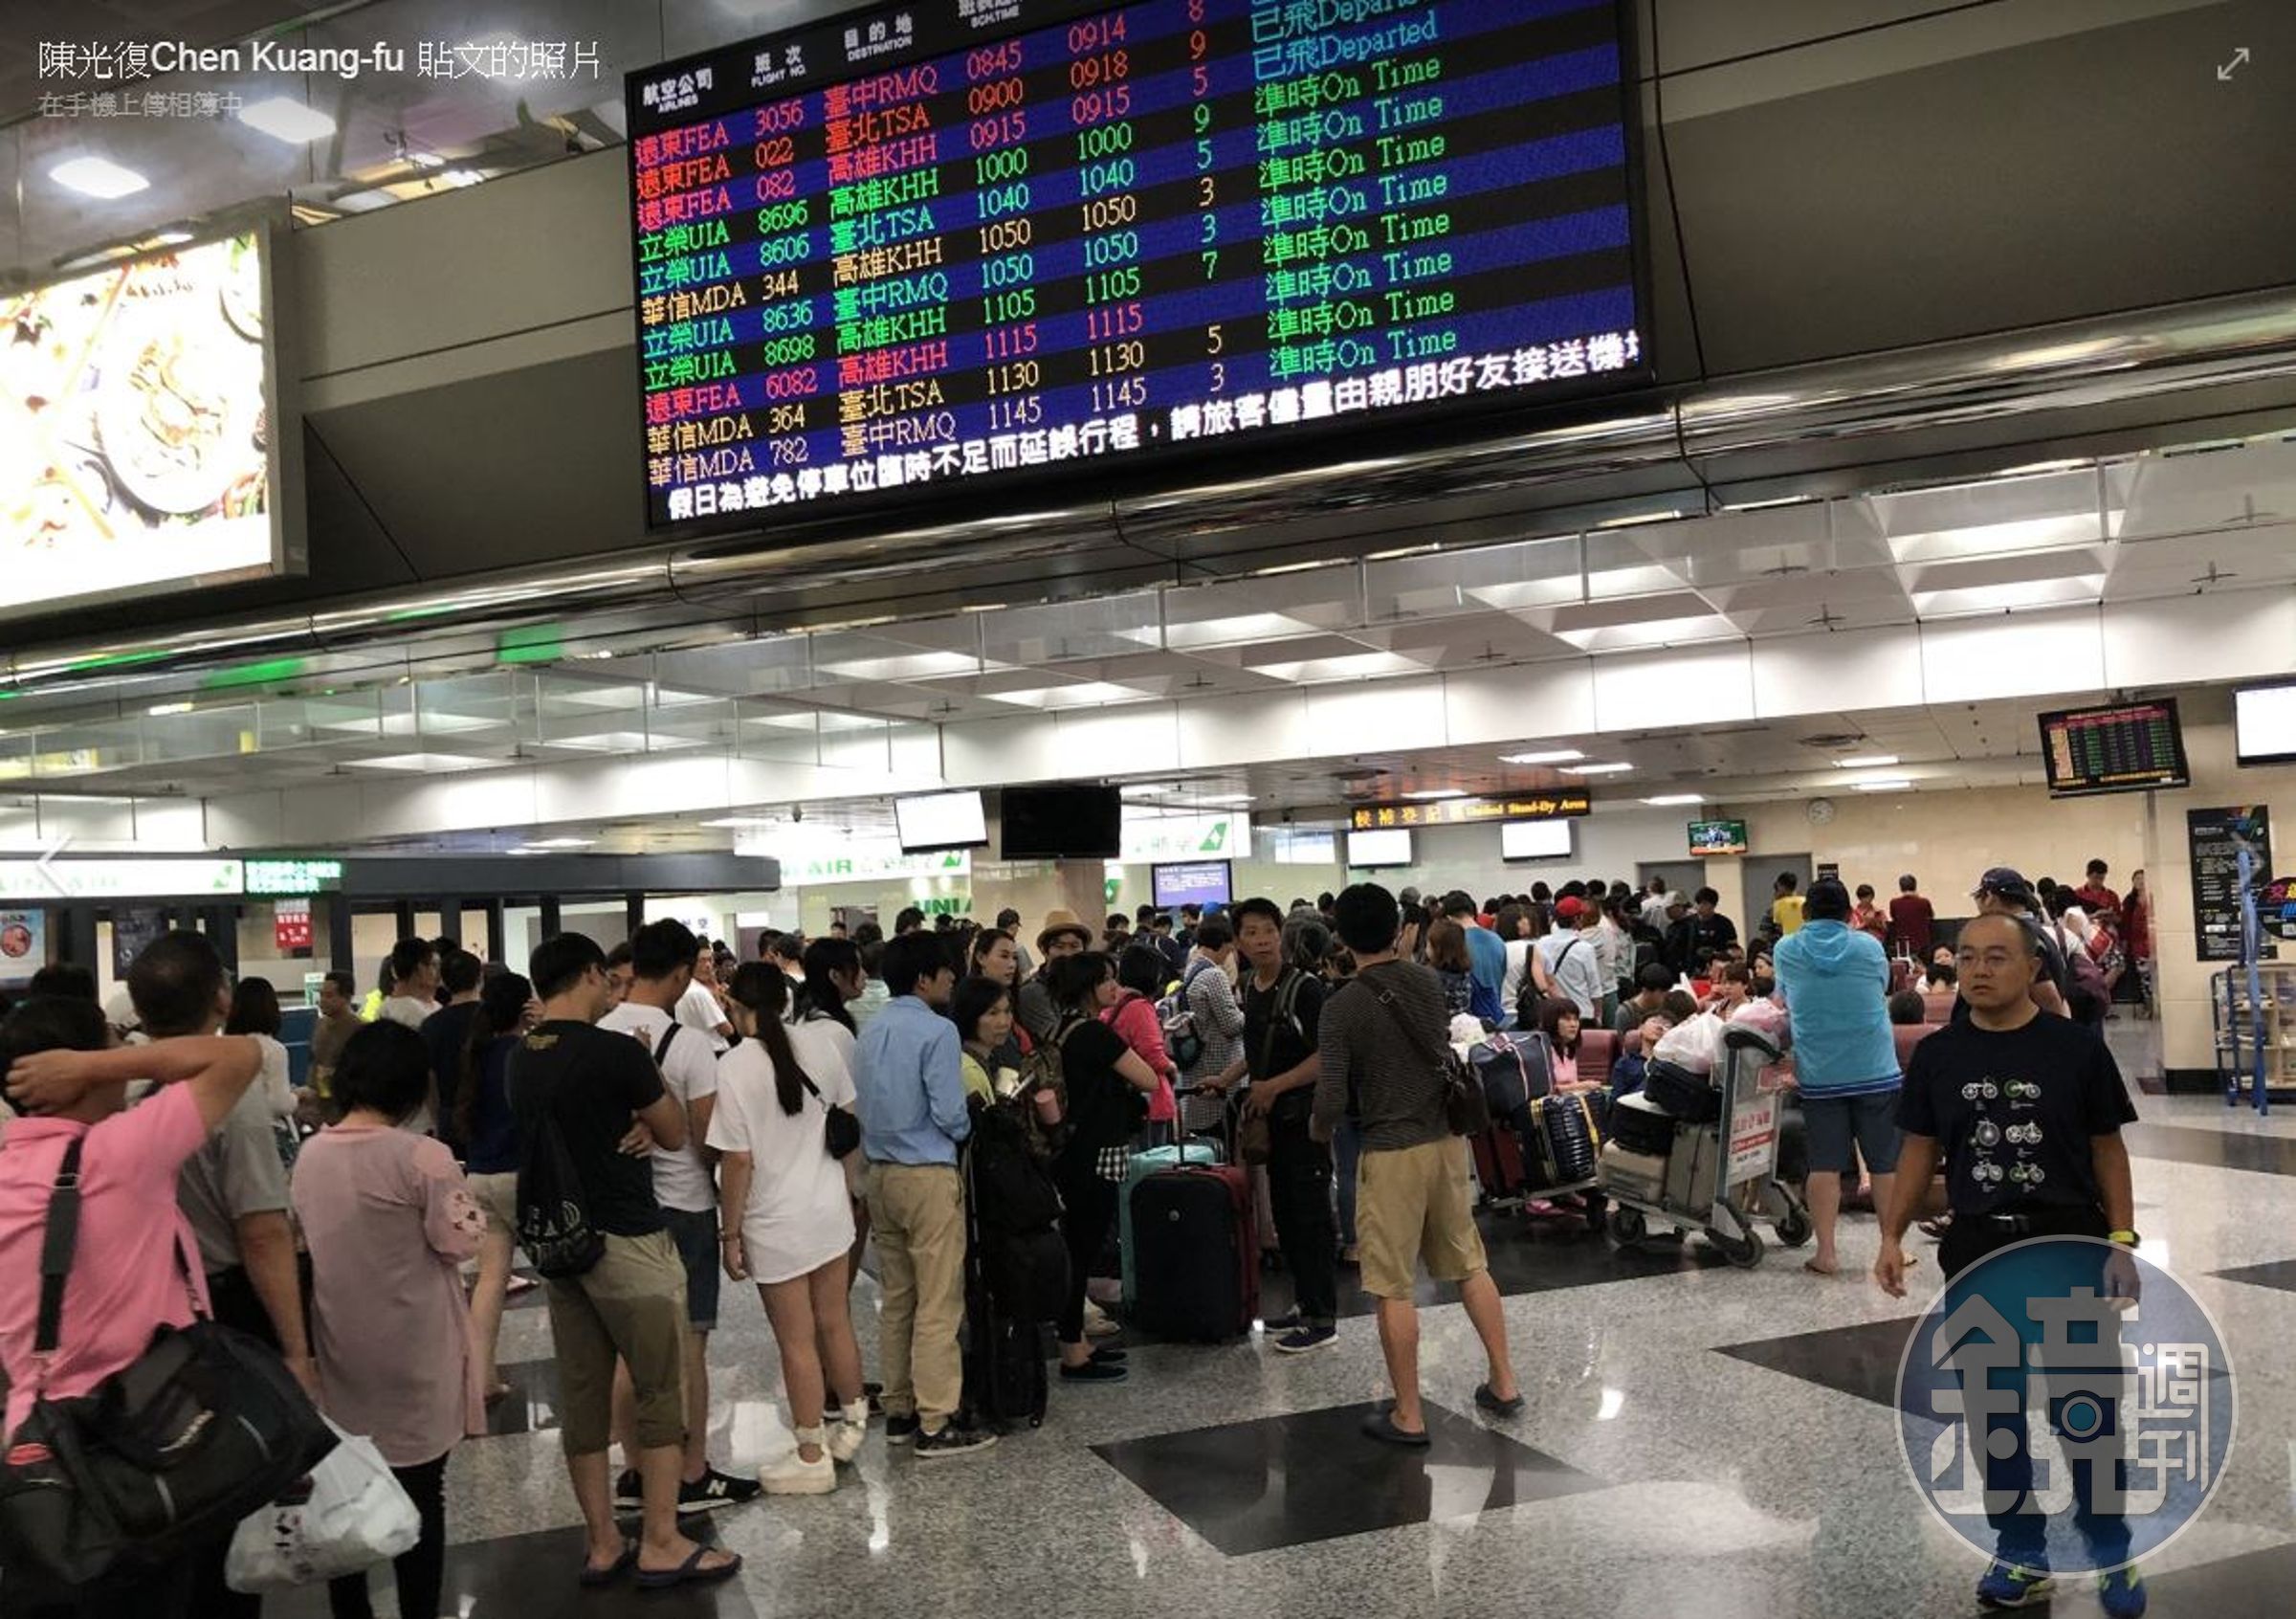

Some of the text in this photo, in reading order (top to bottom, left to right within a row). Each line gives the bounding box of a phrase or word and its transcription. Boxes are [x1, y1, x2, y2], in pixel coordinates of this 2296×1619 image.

[635, 0, 1203, 170] 遠東FEA 3056 臺中RMQ 0845 0914 8
[636, 154, 731, 201] 遠東FEA
[756, 137, 794, 168] 022
[826, 103, 929, 154] 臺北TSA
[969, 78, 1023, 114] 0900
[1071, 50, 1128, 88] 0918
[1191, 31, 1205, 59] 9
[637, 11, 1437, 233] 遠東FEA 082 高雄KHH 0915 0915 5 已飛Departed
[643, 68, 713, 106] 航空公司
[844, 12, 913, 50] 目的地
[658, 94, 698, 113] AIRLINES
[751, 69, 785, 88] FLIGHT
[848, 35, 913, 62] DESTINATION
[639, 58, 1440, 262] 立榮UIA 8696 高雄KHH 1000 1000 9 準時On Time
[640, 97, 1443, 295] 立榮UIA 8606 臺北TSA 1040 1040 5 準時On Time
[642, 135, 1445, 325] 華信MDA 344 高雄KHH 1050 1050 3 準時On Time
[643, 173, 1447, 359] 立榮UIA 8636 臺中RMQ 1050 1050 3 準時On Time
[645, 212, 1449, 390] 立榮UIA 8698 高雄KHH 1105 1105 7 準時On Time
[646, 251, 1452, 424] 遠東FEA 6082 高雄KHH 1115 1115 準時On Time
[648, 290, 1454, 455] 華信MDA 364 臺北TSA 1130 1130 5 準時On Time
[649, 328, 1457, 487] 華信MDA 782 臺中RMQ 1145 1145 3 準時On Time
